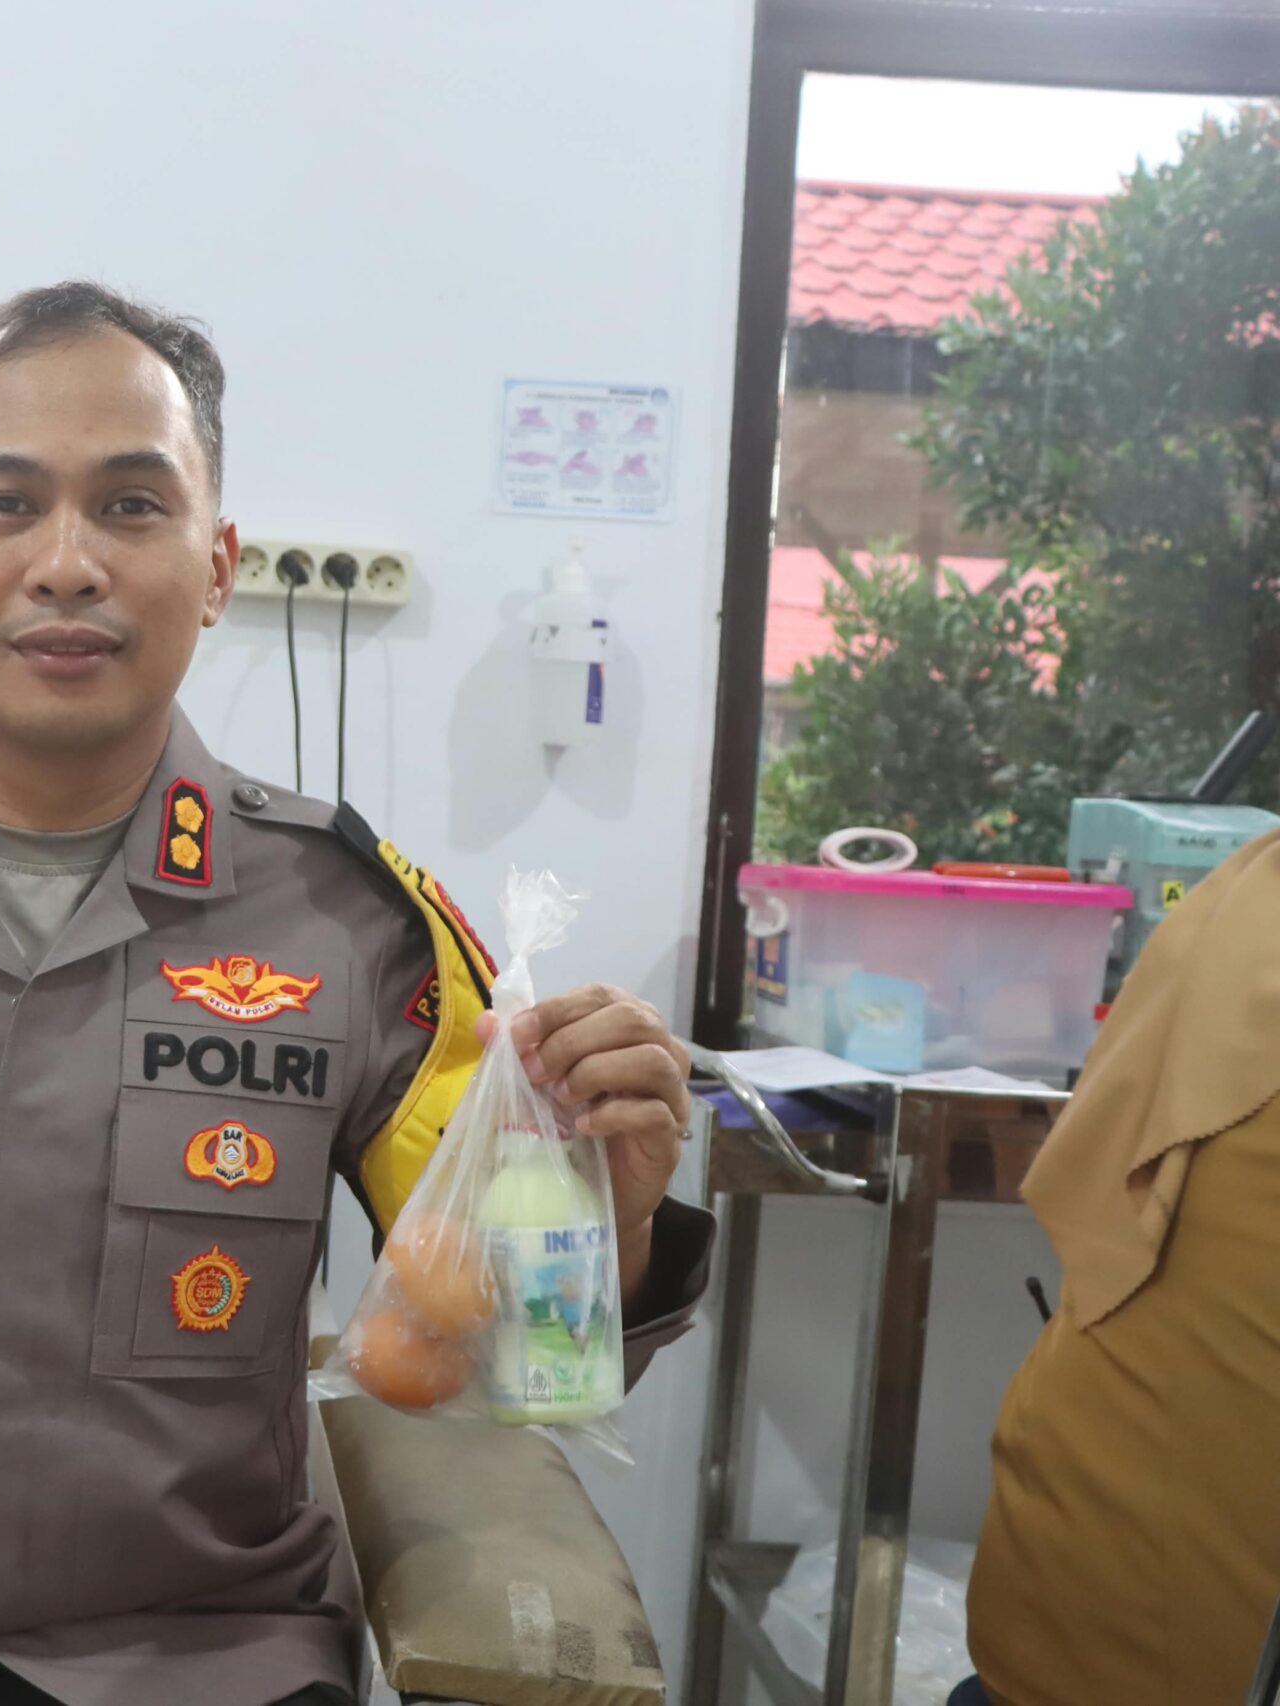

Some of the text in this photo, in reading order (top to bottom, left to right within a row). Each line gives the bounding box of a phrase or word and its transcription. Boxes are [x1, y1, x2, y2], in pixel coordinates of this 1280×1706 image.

[246, 1002, 275, 1016] POLRI
[143, 1032, 328, 1098] POLRI
[223, 1129, 243, 1142] SAR
